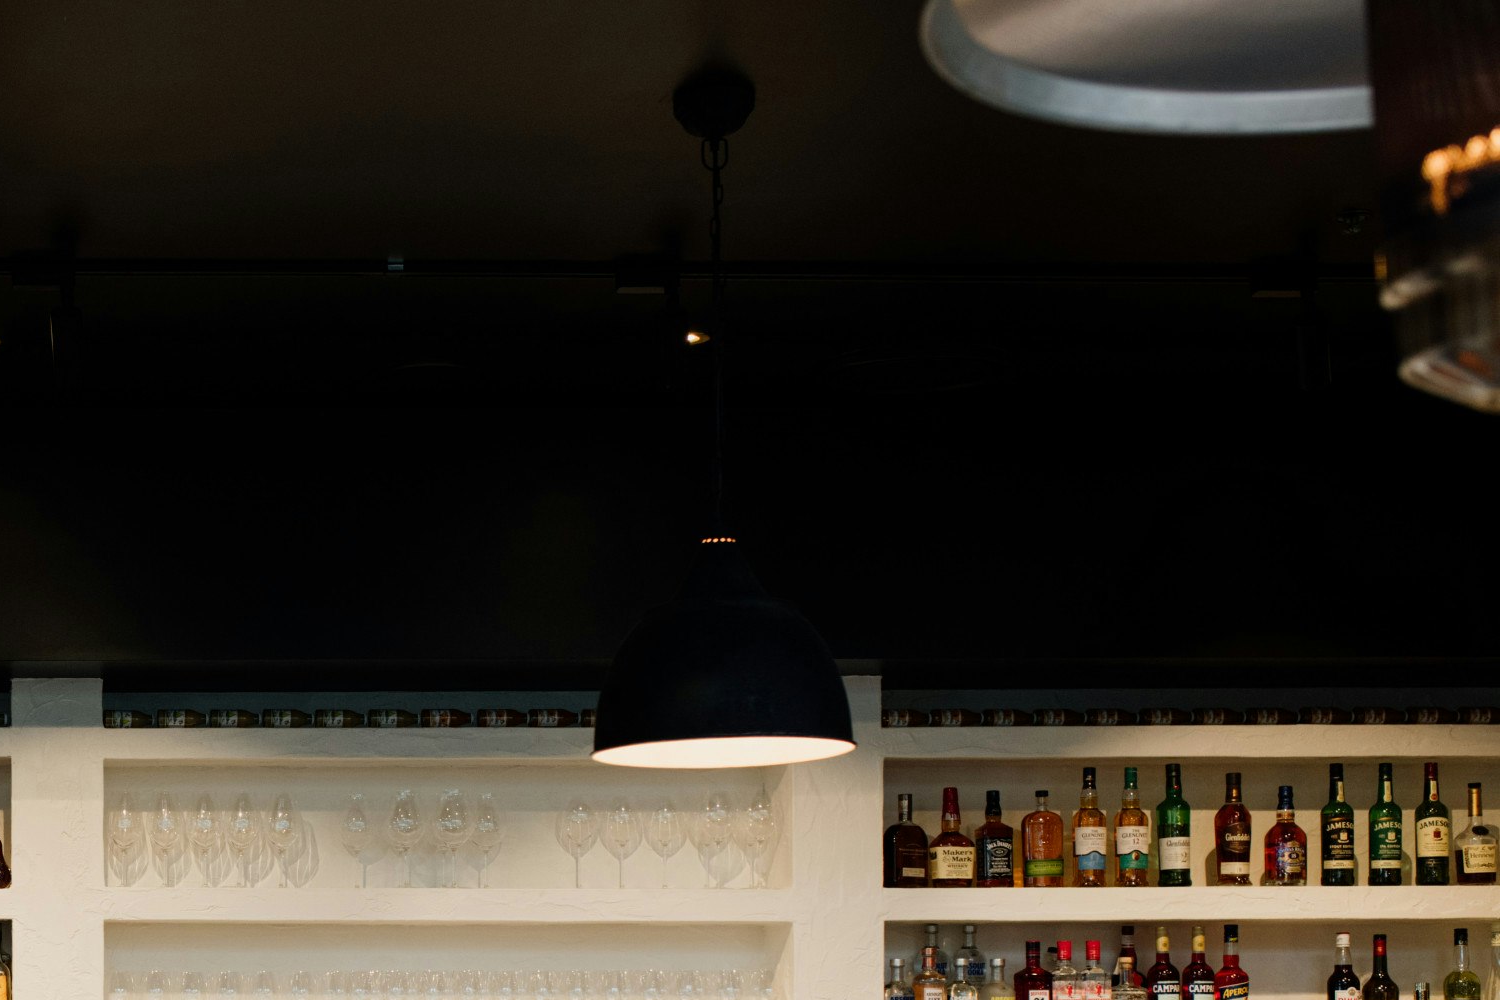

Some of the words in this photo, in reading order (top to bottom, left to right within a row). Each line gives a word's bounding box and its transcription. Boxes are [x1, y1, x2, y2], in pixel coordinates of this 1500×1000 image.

[1327, 821, 1354, 832] JAMESO
[1374, 821, 1401, 832] JAMESO
[1153, 985, 1180, 993] CAMPA
[1189, 985, 1215, 993] CAMPA
